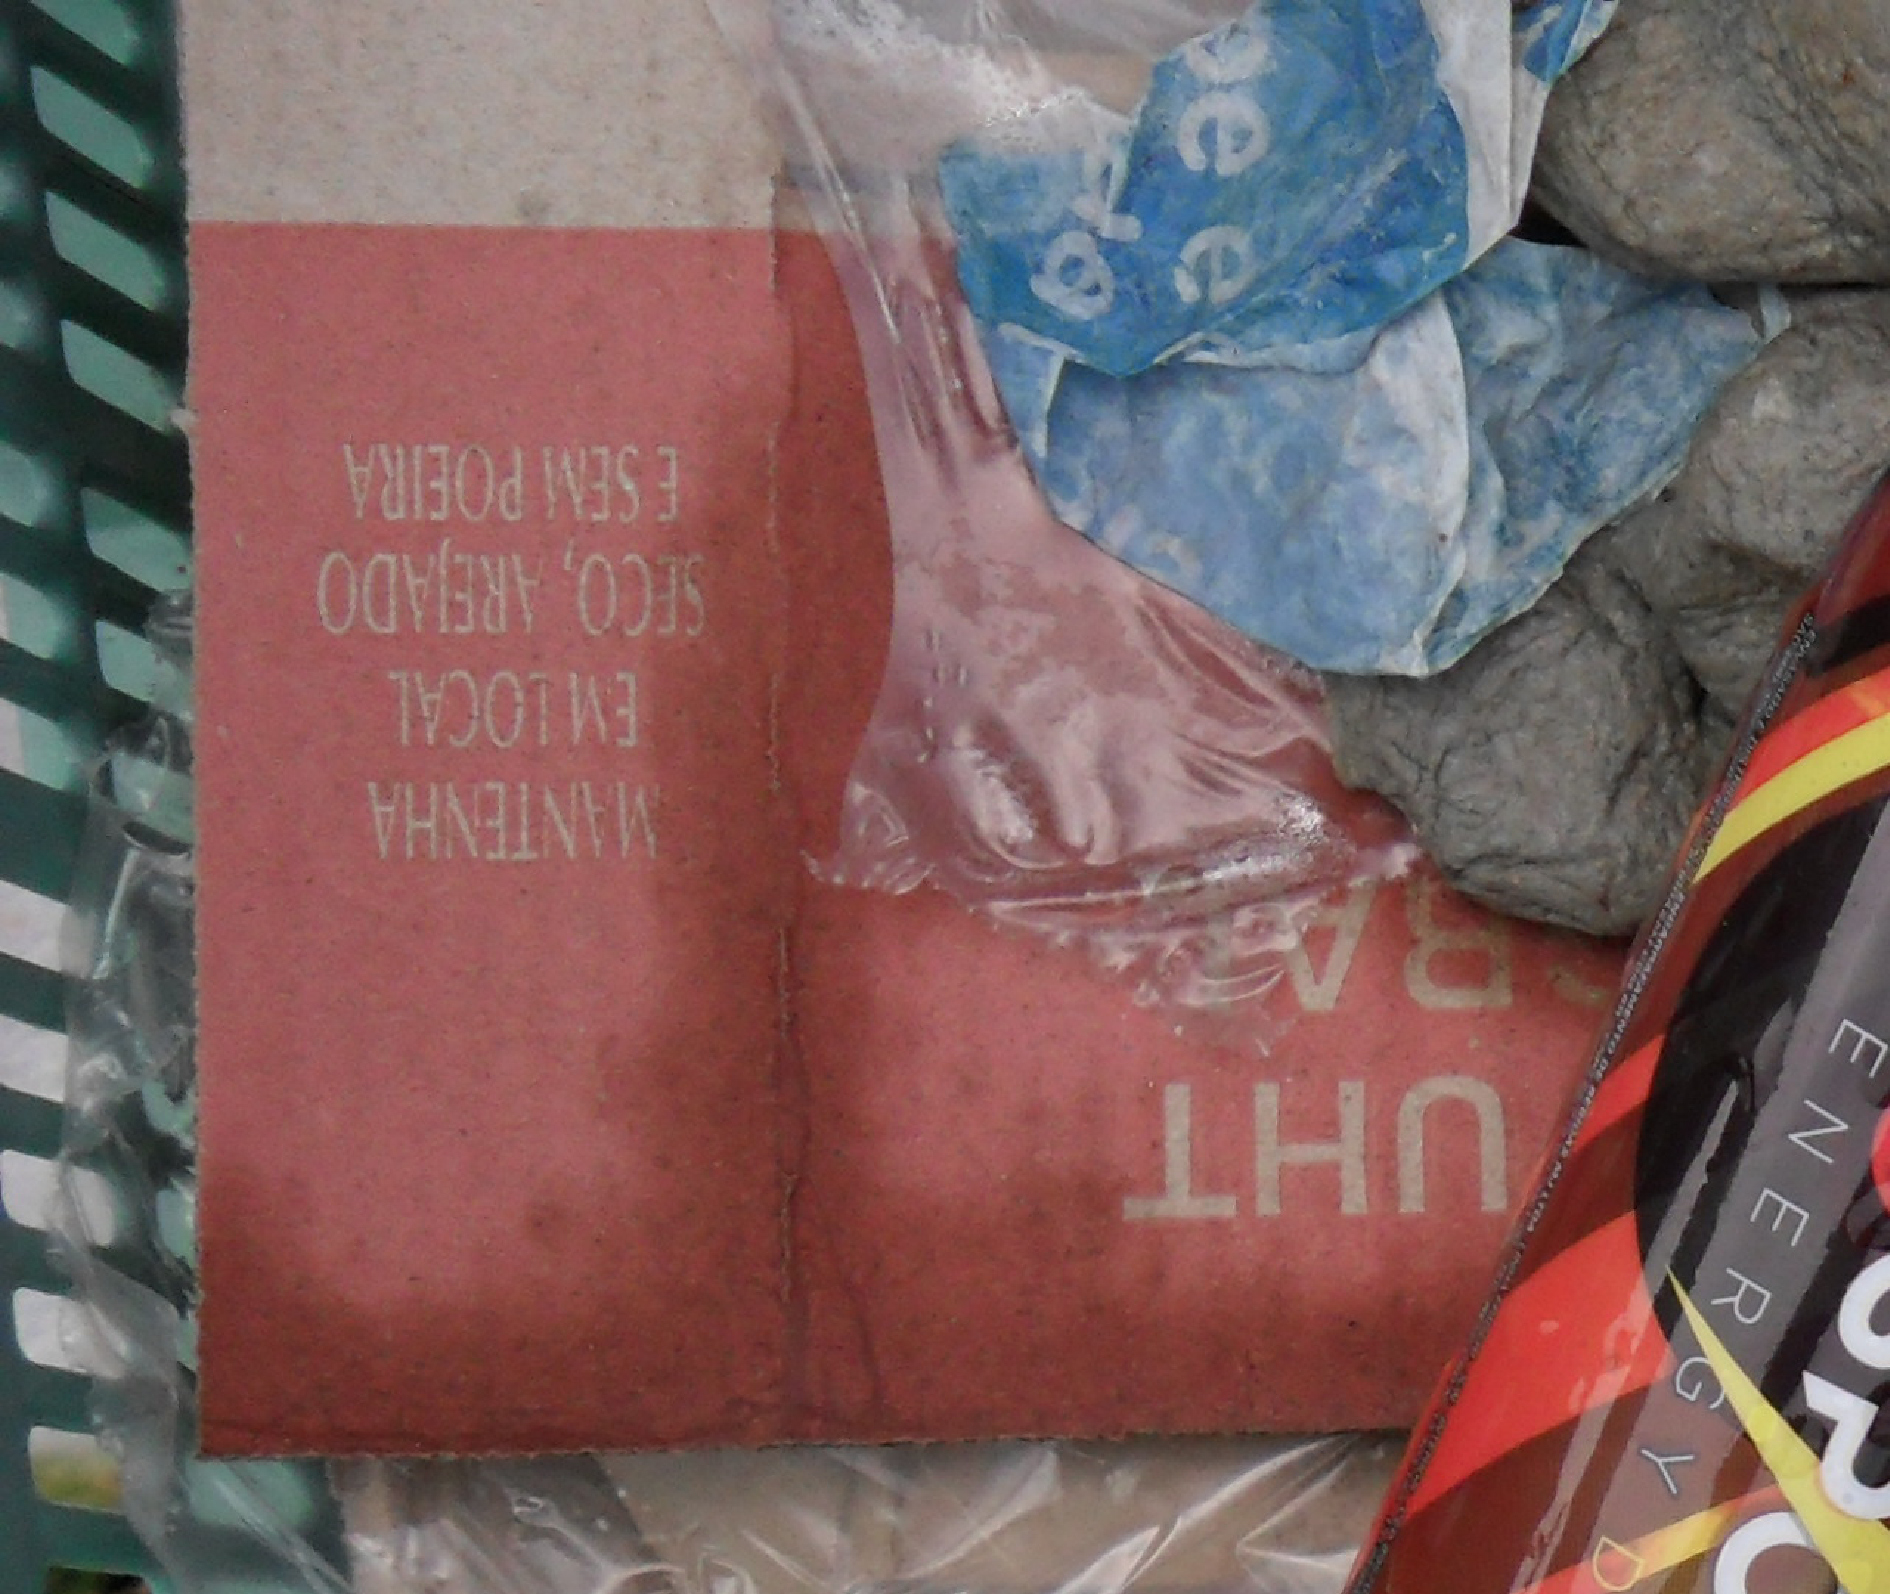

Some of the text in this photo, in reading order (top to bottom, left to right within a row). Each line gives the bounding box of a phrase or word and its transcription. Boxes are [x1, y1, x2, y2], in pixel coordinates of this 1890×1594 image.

[342, 442, 680, 523] E SEM POEIRA
[316, 538, 706, 636] SECO, AREJADO
[387, 670, 637, 747] EM LOCAL
[366, 780, 663, 861] MANTENHA
[1121, 1074, 1508, 1223] UHT
[1640, 1017, 1889, 1497] ENERGY
